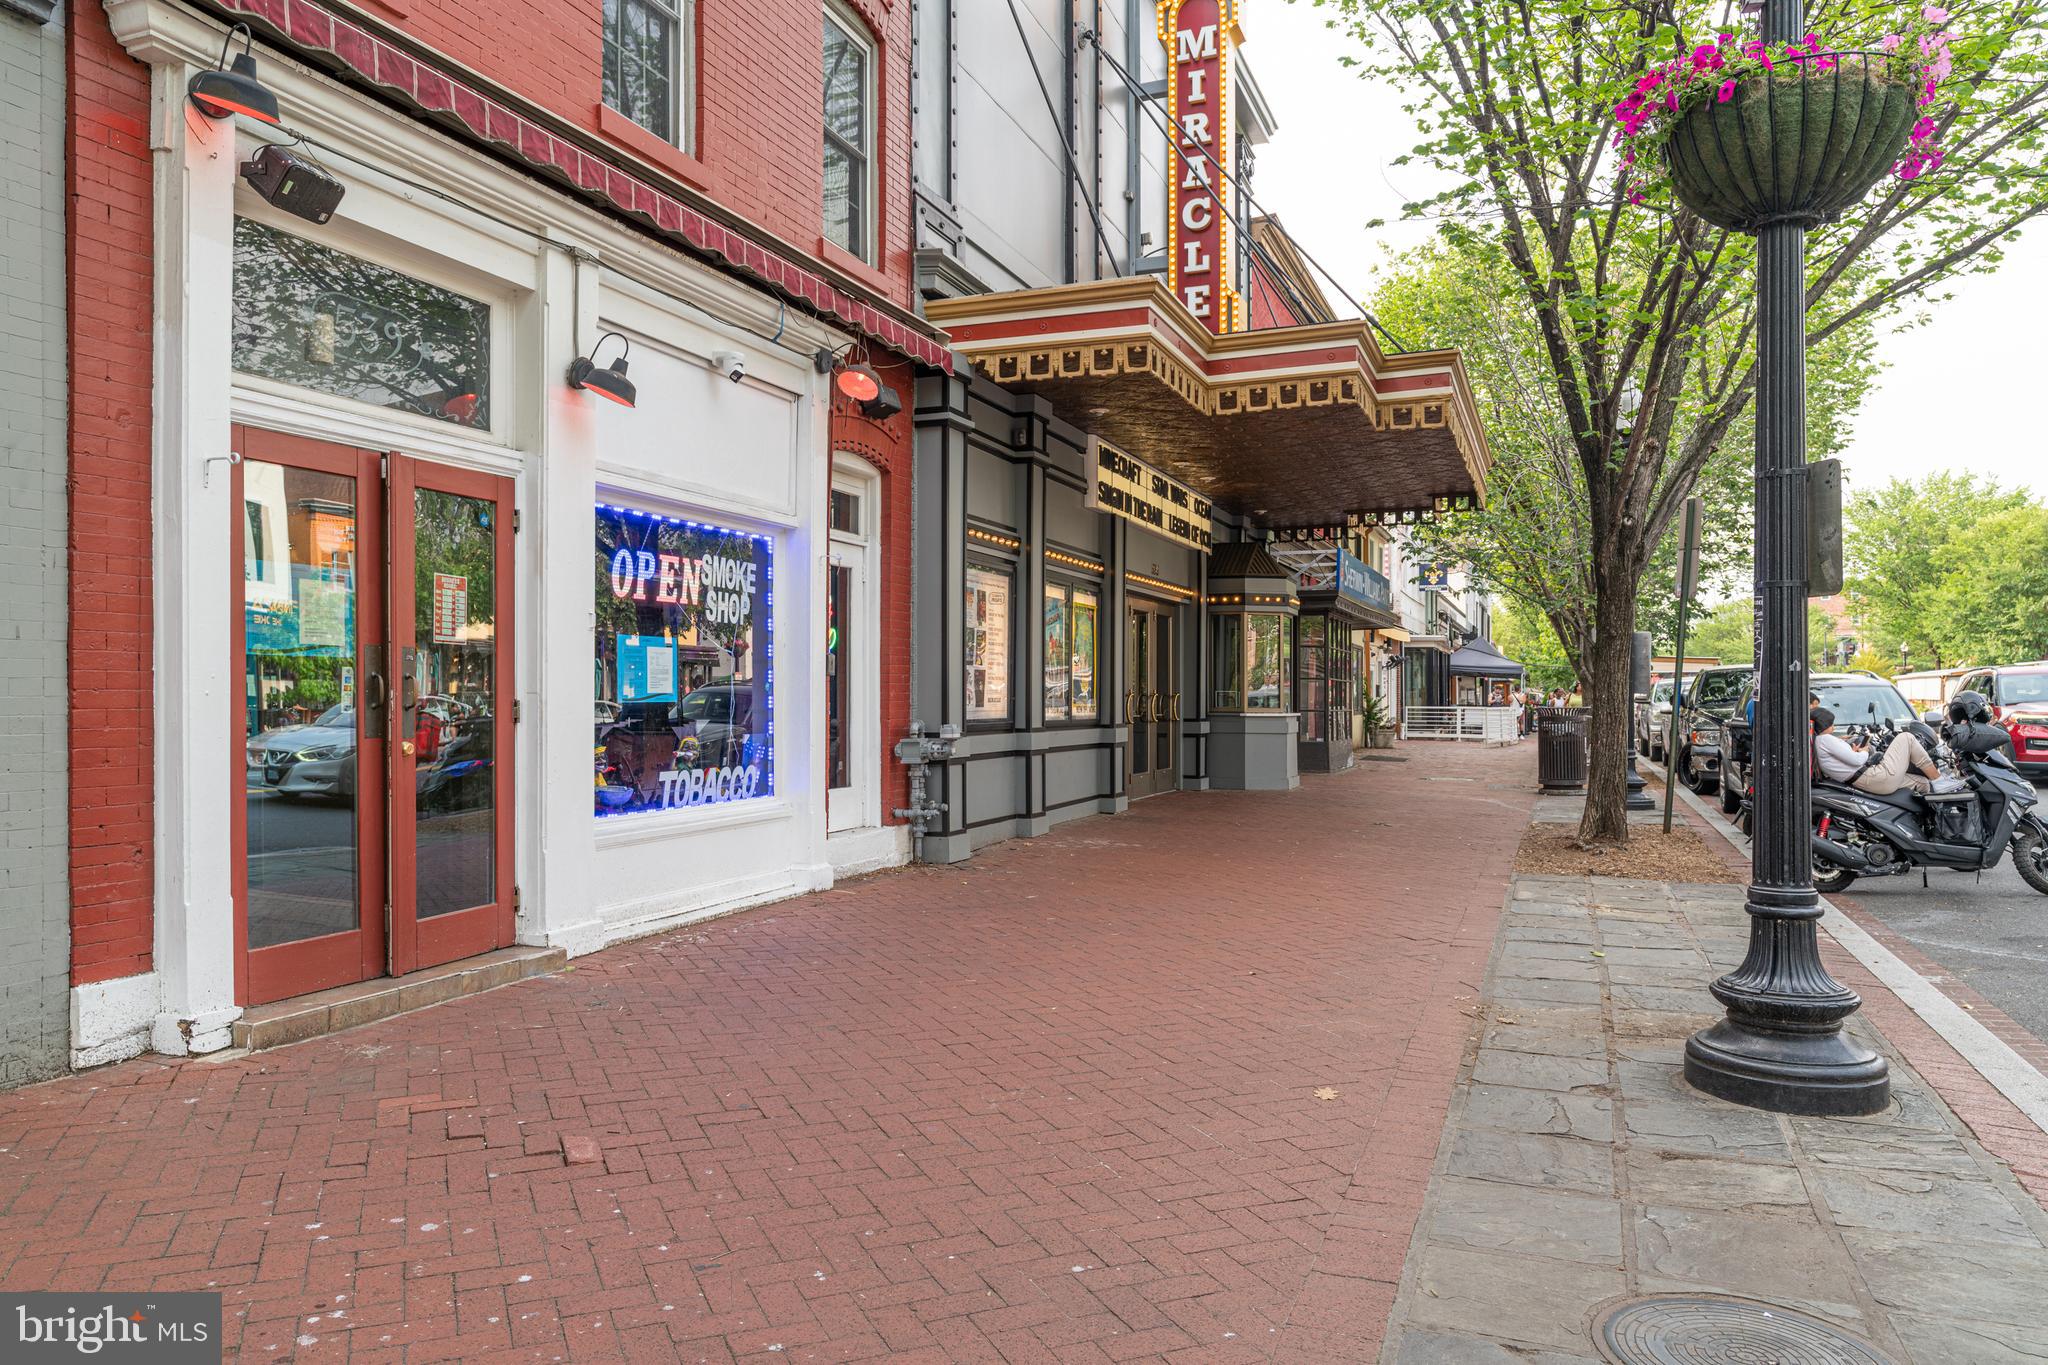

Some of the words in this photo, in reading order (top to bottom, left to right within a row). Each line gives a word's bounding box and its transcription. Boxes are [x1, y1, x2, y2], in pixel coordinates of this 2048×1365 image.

[1176, 24, 1218, 319] MIRACLE
[336, 304, 403, 361] 539
[611, 548, 703, 606] OPEN
[701, 553, 757, 594] SMOKE
[705, 590, 751, 626] SHOP
[659, 764, 756, 810] TOBACCO
